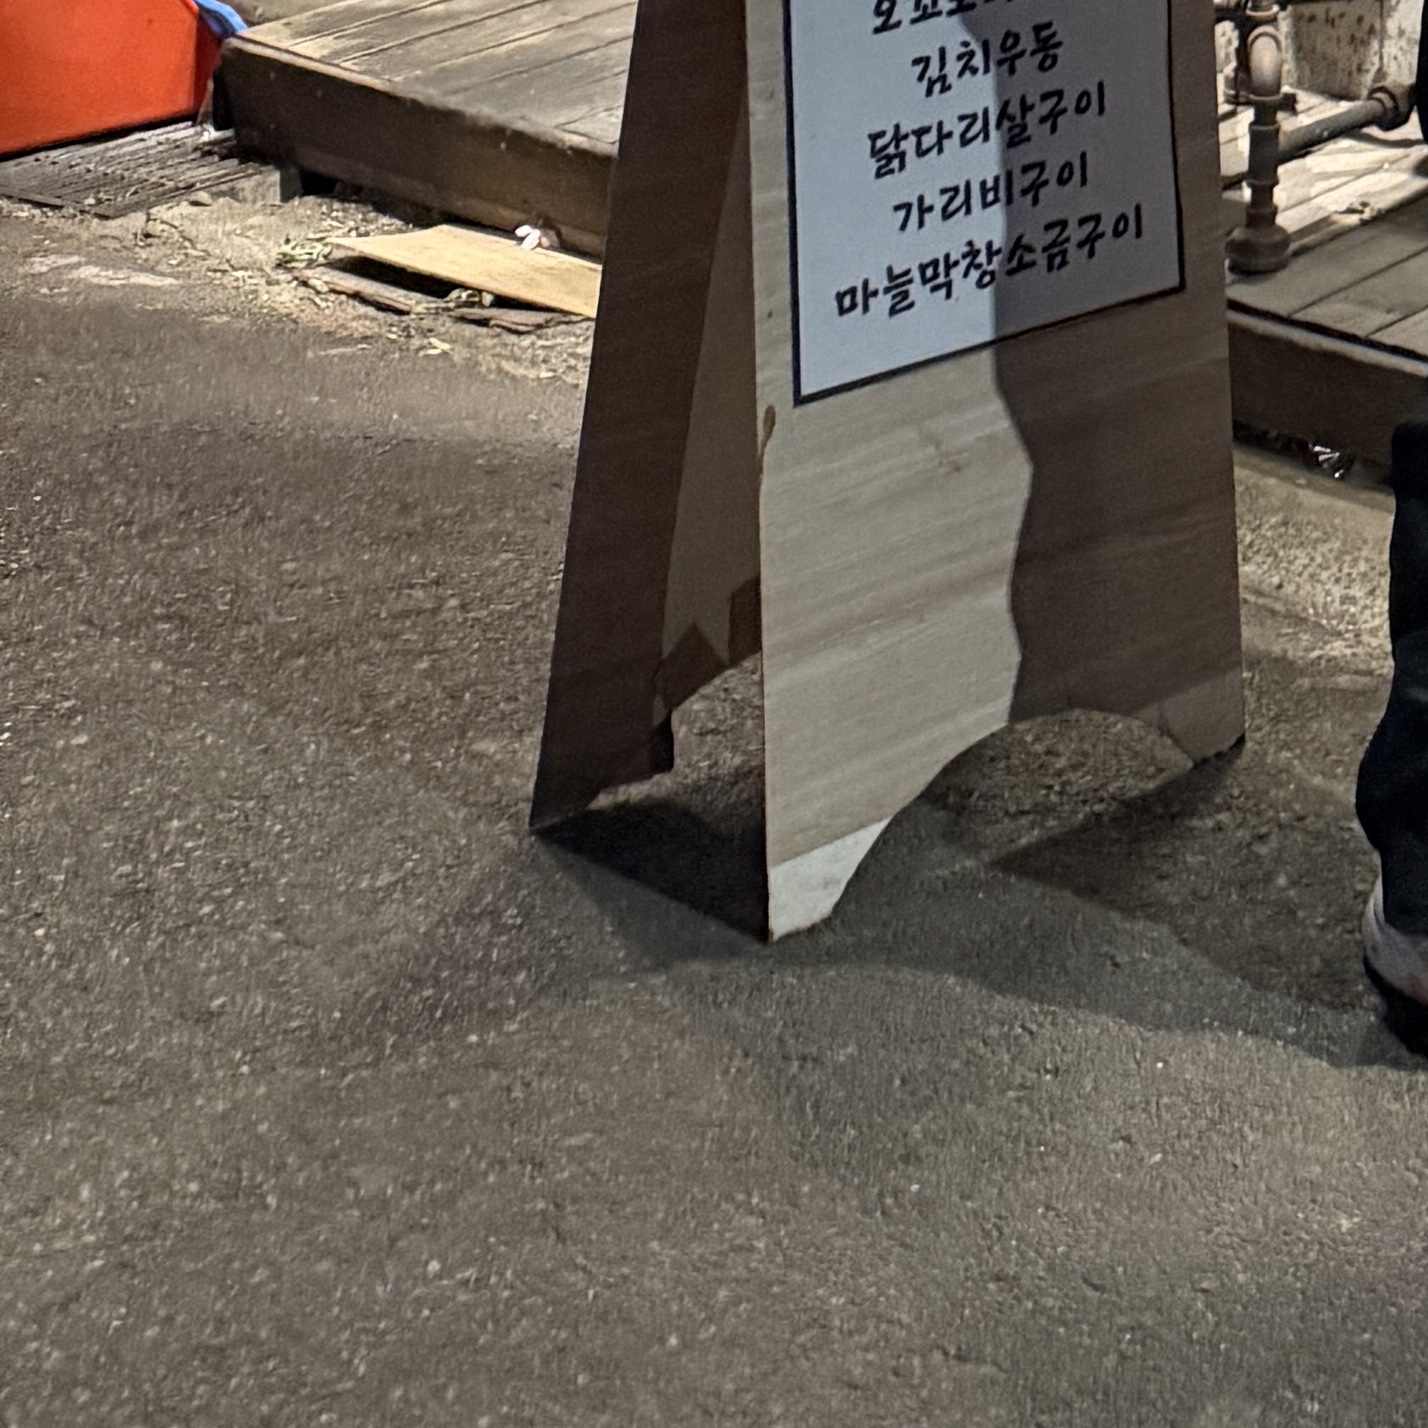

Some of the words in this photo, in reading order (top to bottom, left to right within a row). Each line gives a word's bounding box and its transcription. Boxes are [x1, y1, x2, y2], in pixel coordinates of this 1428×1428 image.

[912, 21, 1064, 98] 김치우동
[868, 81, 1108, 180] 닭다리살구이
[893, 152, 1090, 232] 가리비구이
[835, 204, 1144, 319] 마늘막창소금구이
